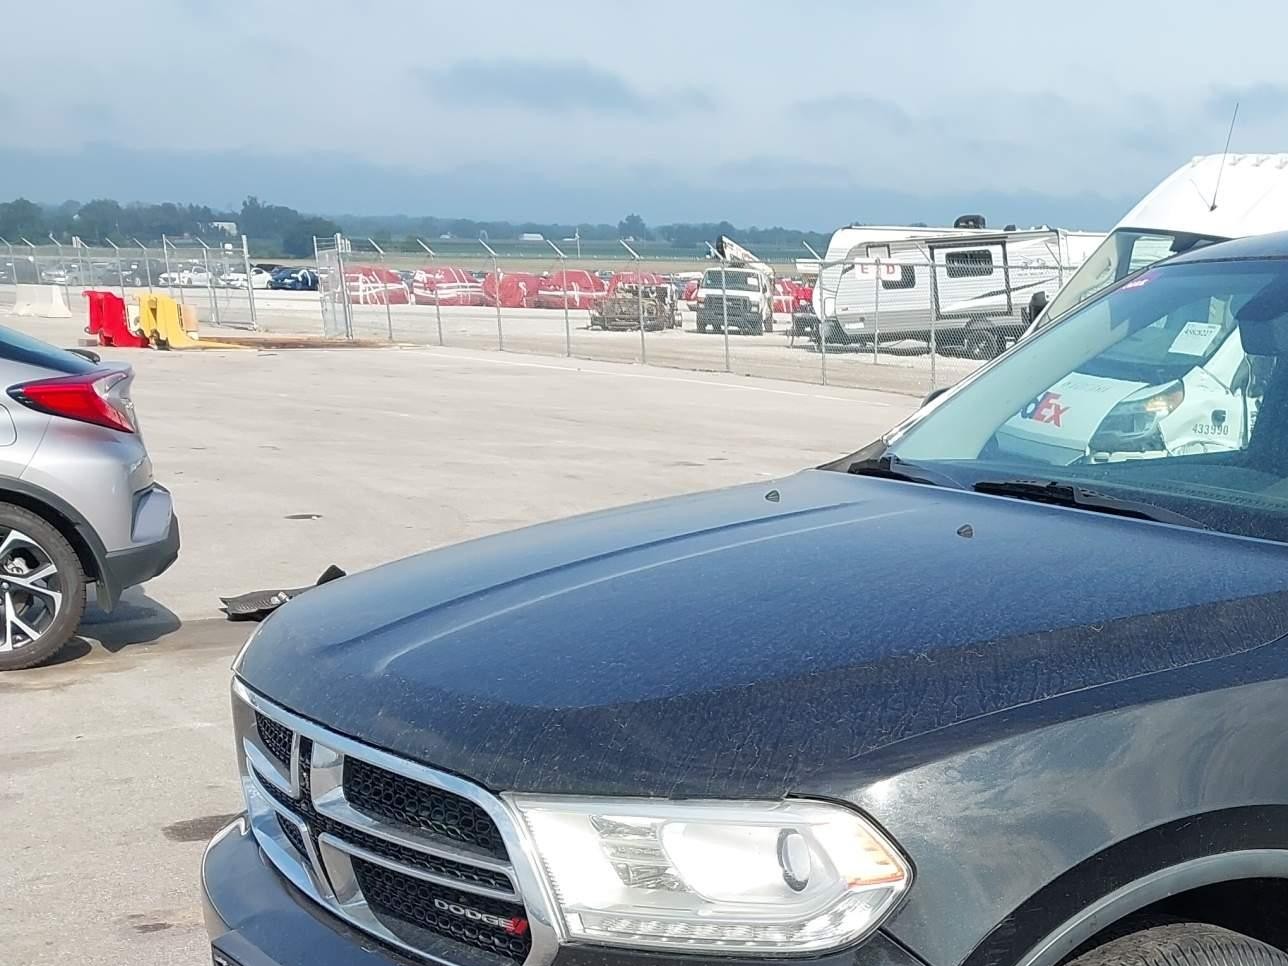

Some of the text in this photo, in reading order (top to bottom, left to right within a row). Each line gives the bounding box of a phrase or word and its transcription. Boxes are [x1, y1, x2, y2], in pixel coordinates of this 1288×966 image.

[885, 263, 896, 275] D
[1191, 423, 1230, 436] 433990
[433, 898, 516, 930] DODGE
